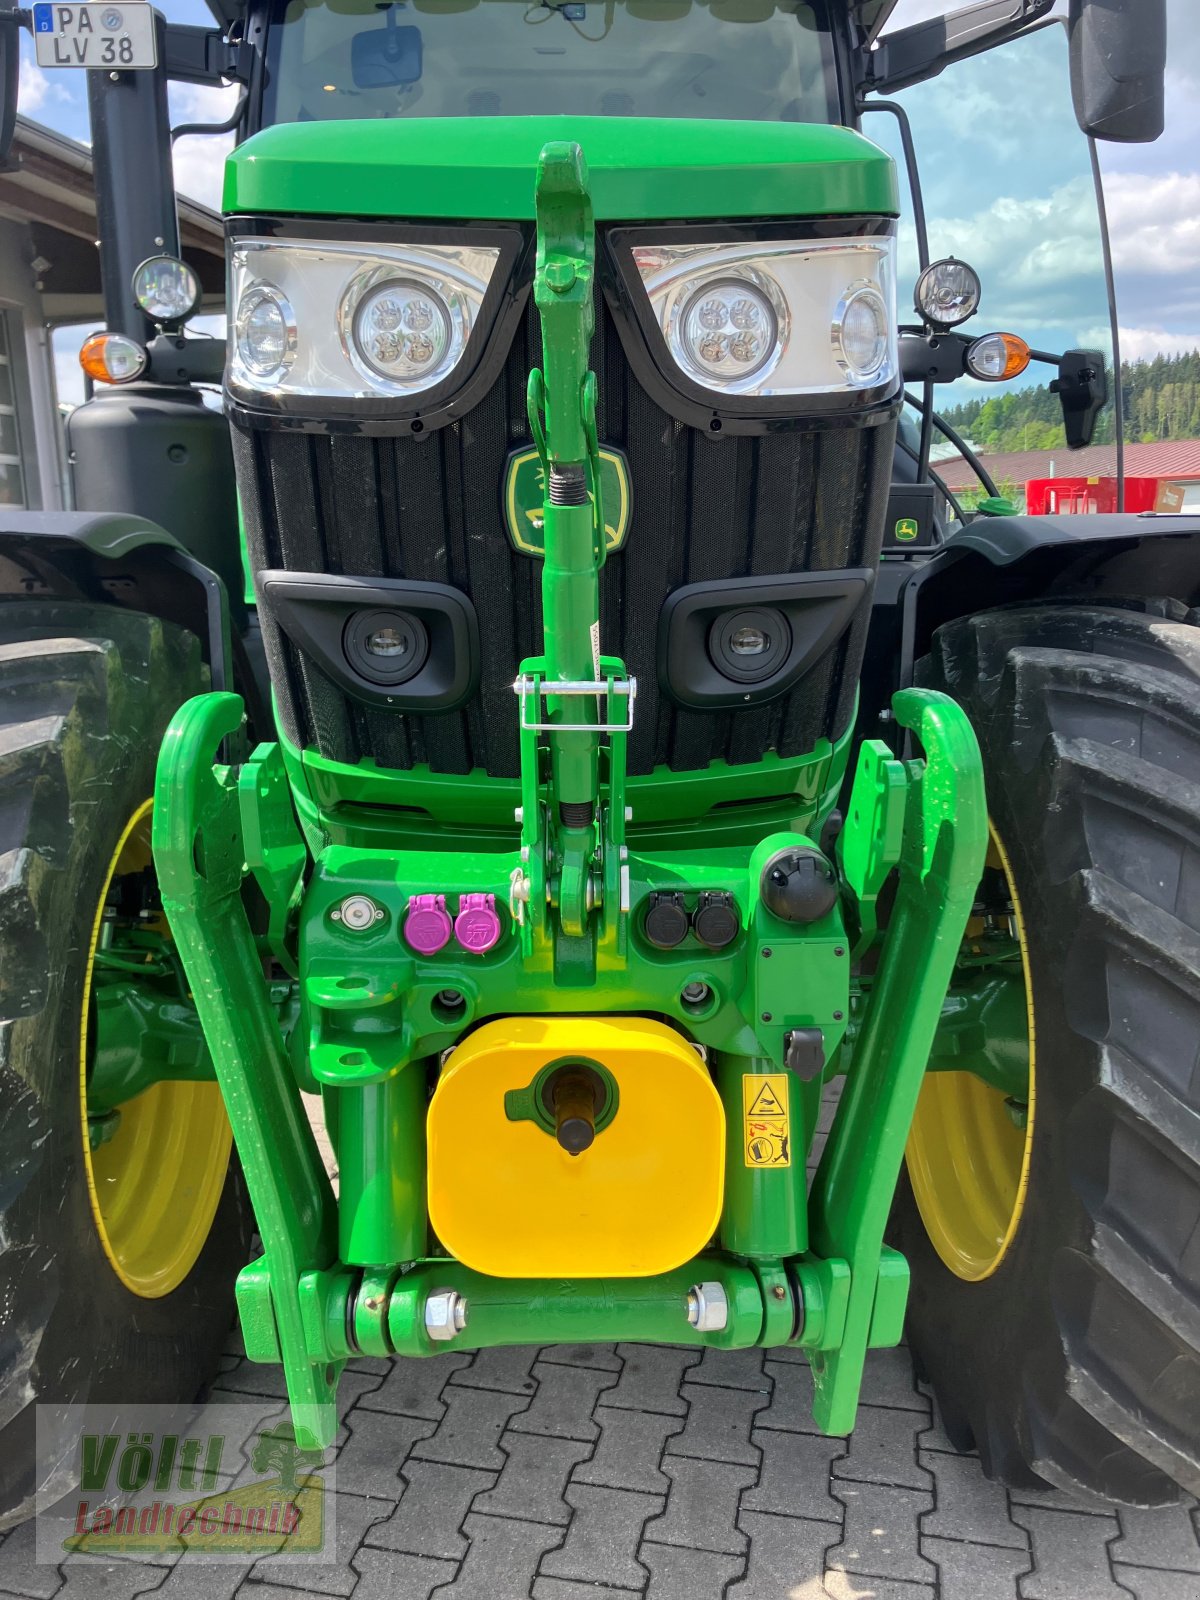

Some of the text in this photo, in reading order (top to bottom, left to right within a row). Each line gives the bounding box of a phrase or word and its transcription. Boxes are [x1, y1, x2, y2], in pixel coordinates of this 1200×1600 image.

[41, 22, 48, 31] D
[57, 7, 93, 33] PA
[54, 37, 133, 63] LV 38
